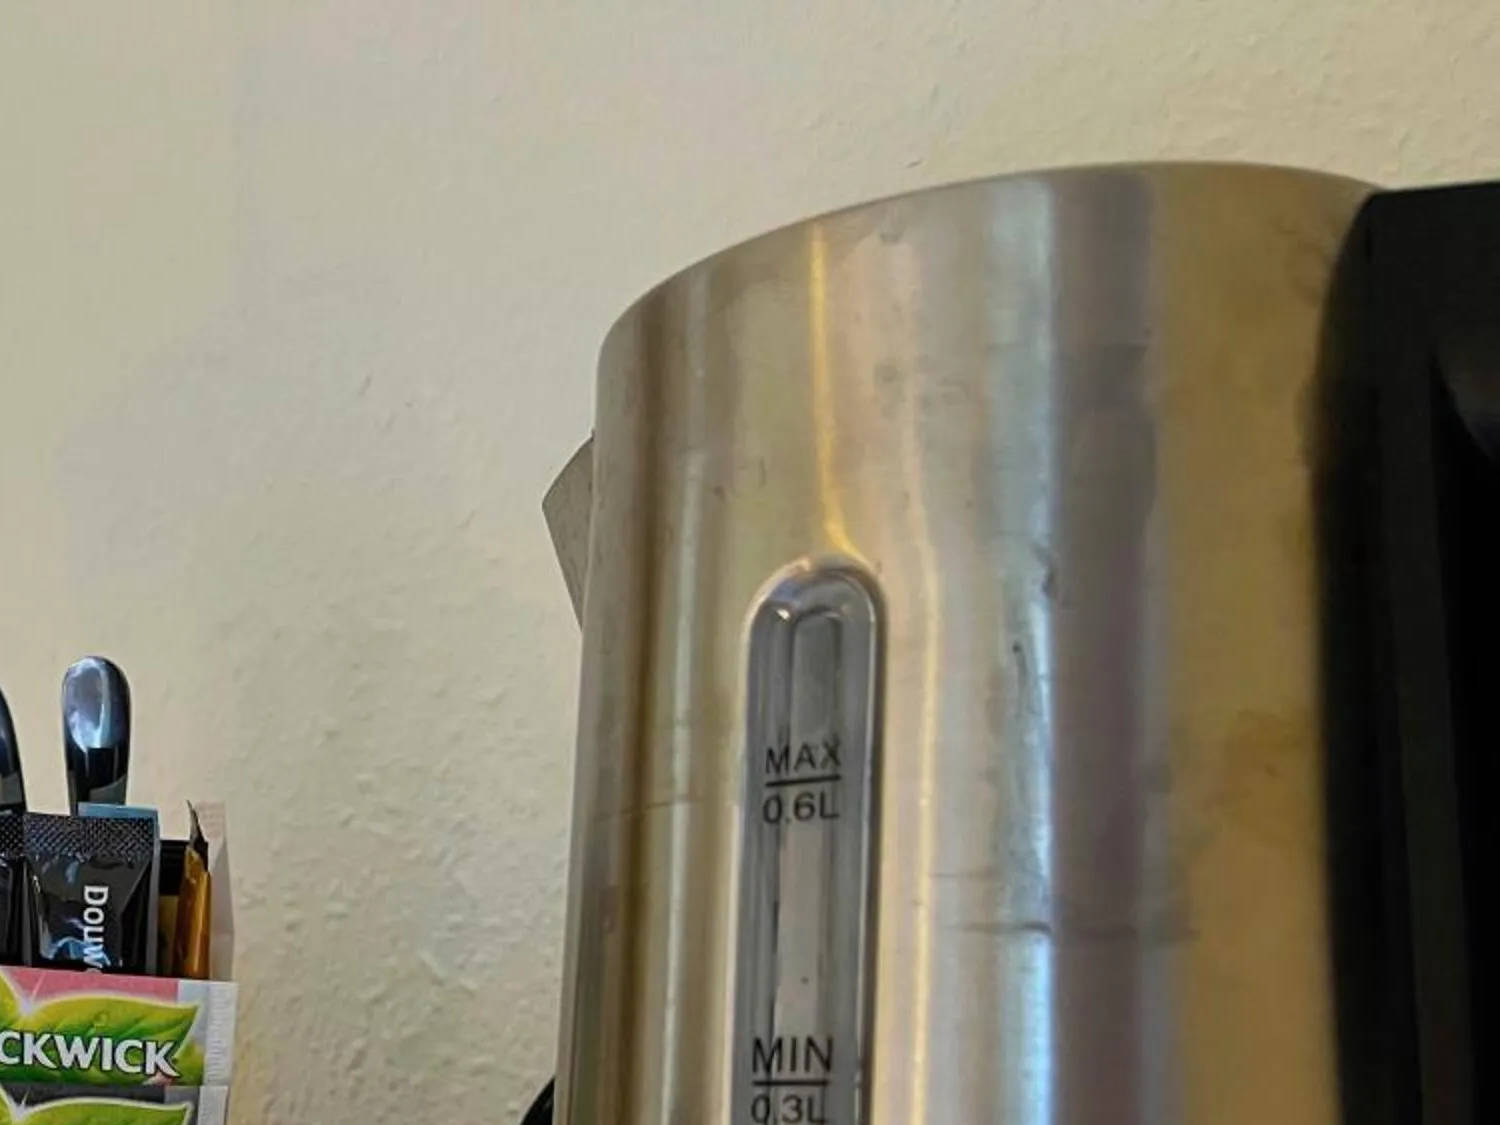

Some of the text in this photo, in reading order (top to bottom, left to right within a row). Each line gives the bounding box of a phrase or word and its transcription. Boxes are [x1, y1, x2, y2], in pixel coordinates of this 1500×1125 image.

[765, 738, 841, 775] MAX
[762, 791, 840, 825] 0.6L
[752, 1036, 833, 1073] MIN
